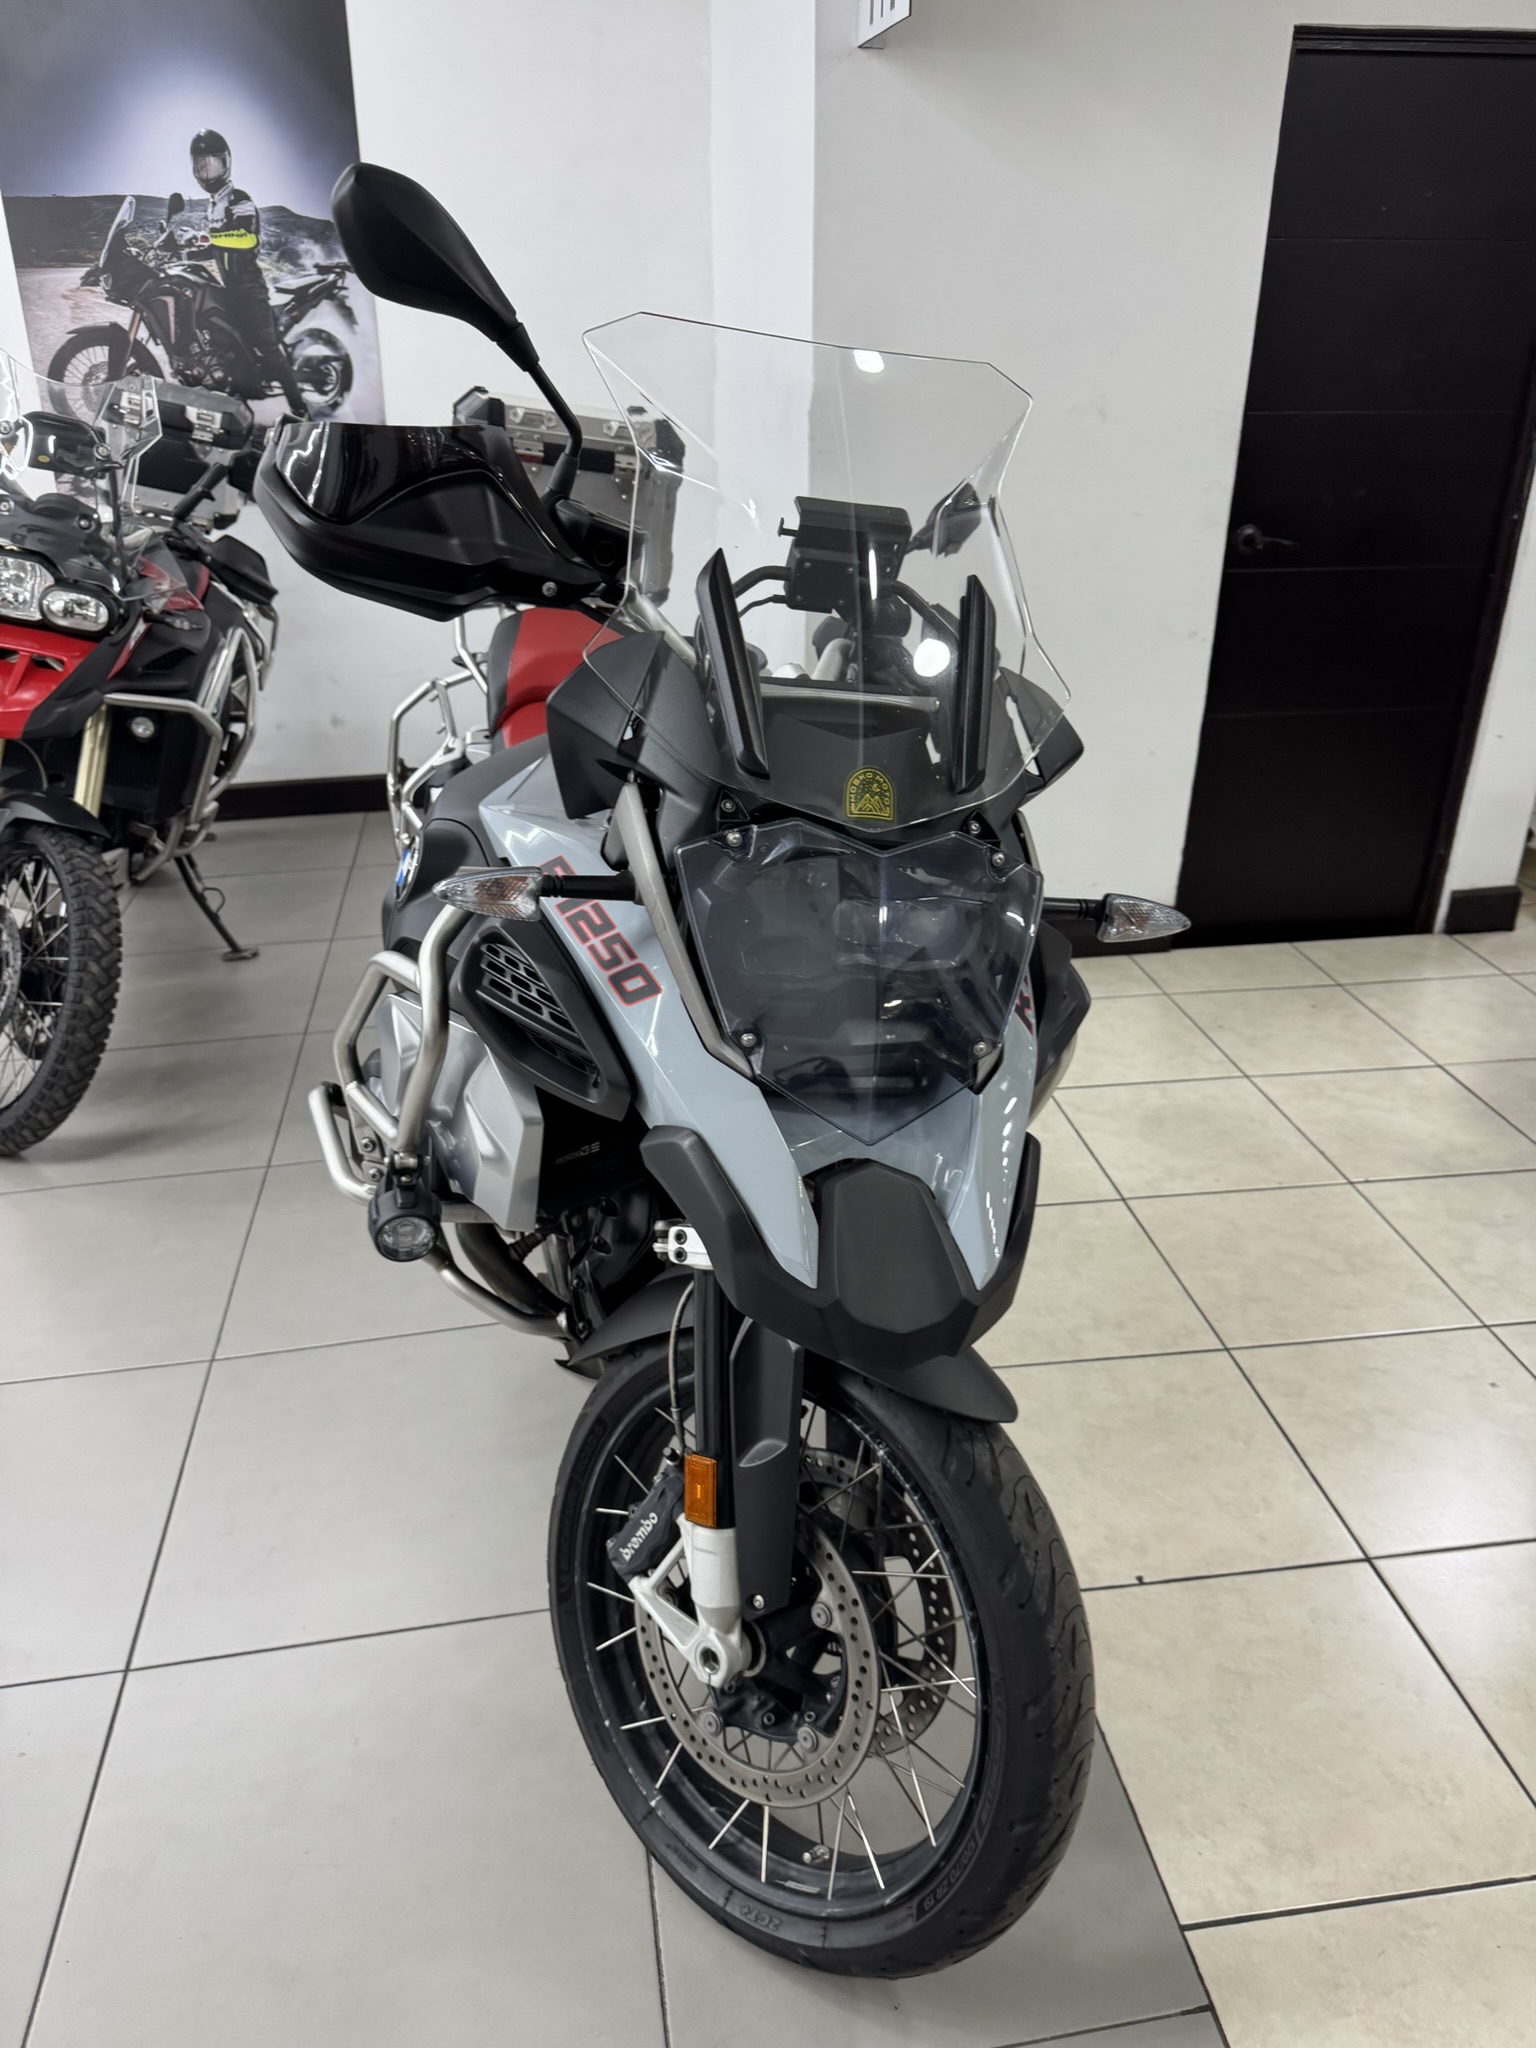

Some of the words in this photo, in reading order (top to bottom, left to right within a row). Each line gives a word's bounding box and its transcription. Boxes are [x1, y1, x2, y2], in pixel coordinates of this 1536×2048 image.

[850, 772, 873, 802] MOSKO
[875, 775, 891, 805] MOTO
[618, 1512, 659, 1562] brembo
